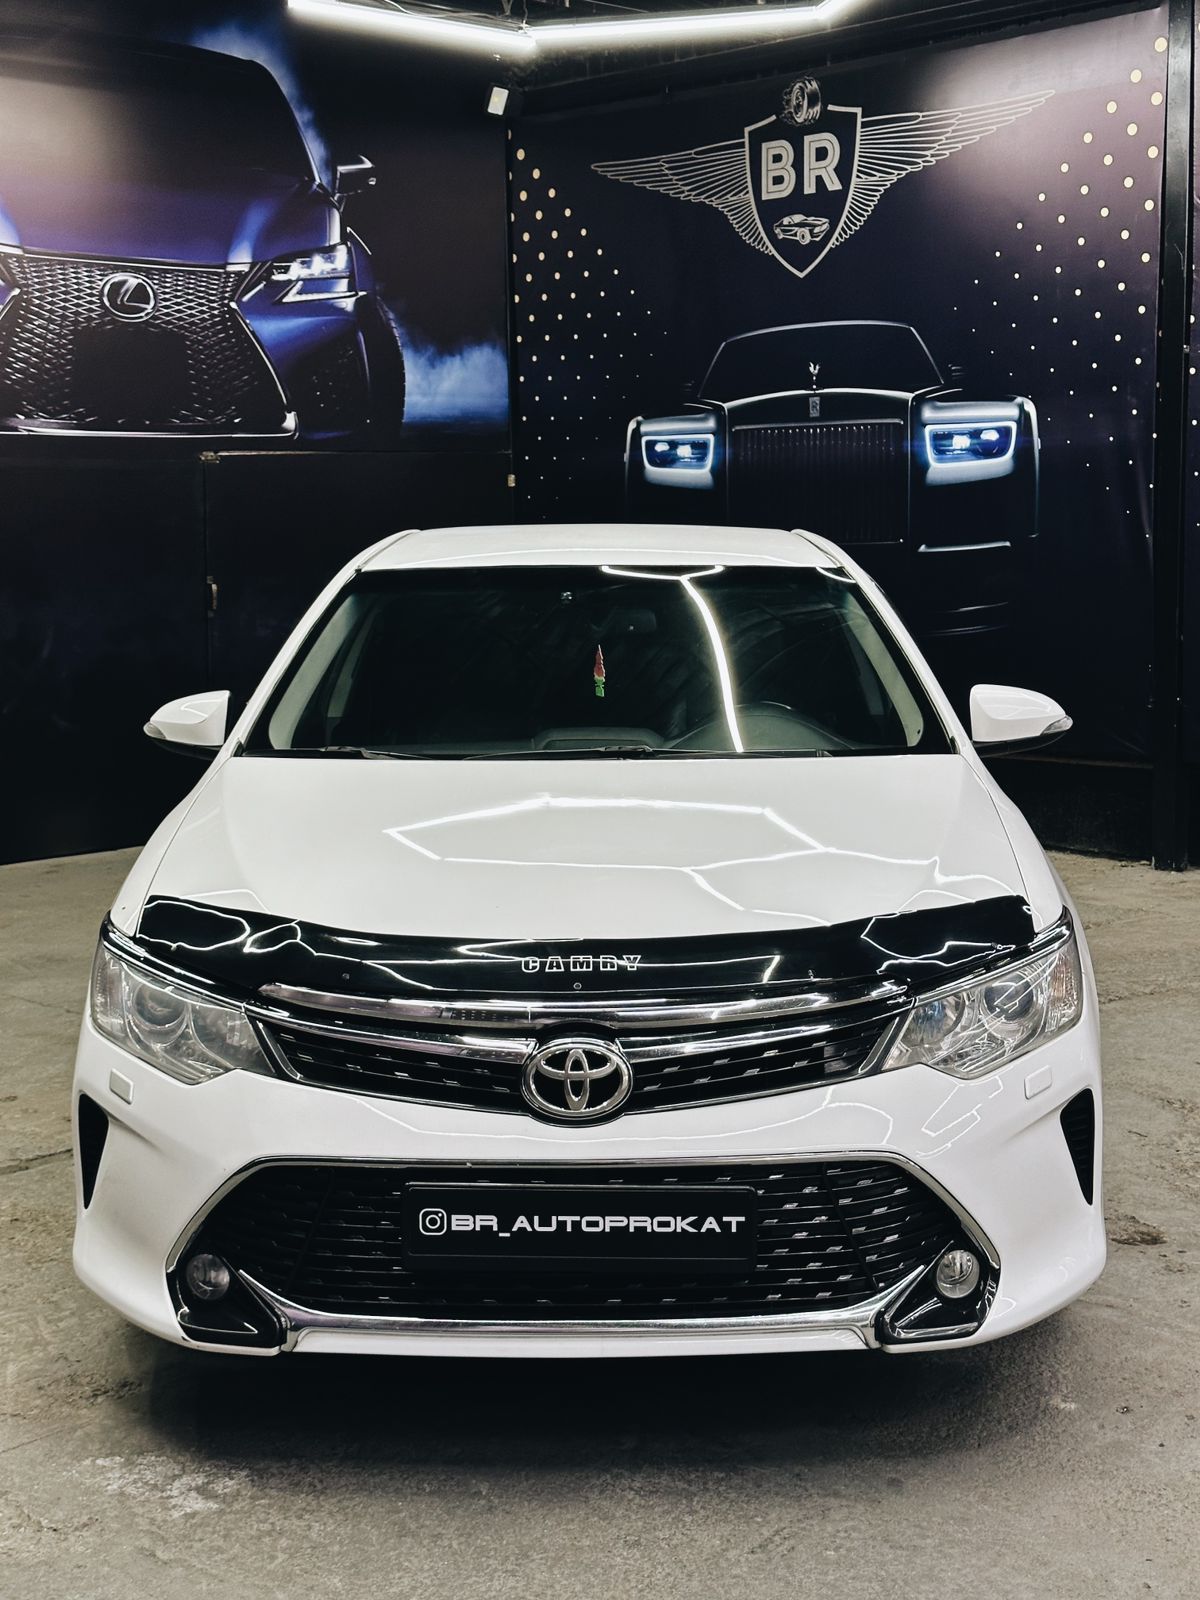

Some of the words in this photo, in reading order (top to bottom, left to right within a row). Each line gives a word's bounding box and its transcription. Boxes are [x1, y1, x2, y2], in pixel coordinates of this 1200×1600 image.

[761, 131, 843, 201] BR
[521, 954, 642, 973] CAMRY
[450, 1214, 746, 1237] BR_AUTOPROKAT
